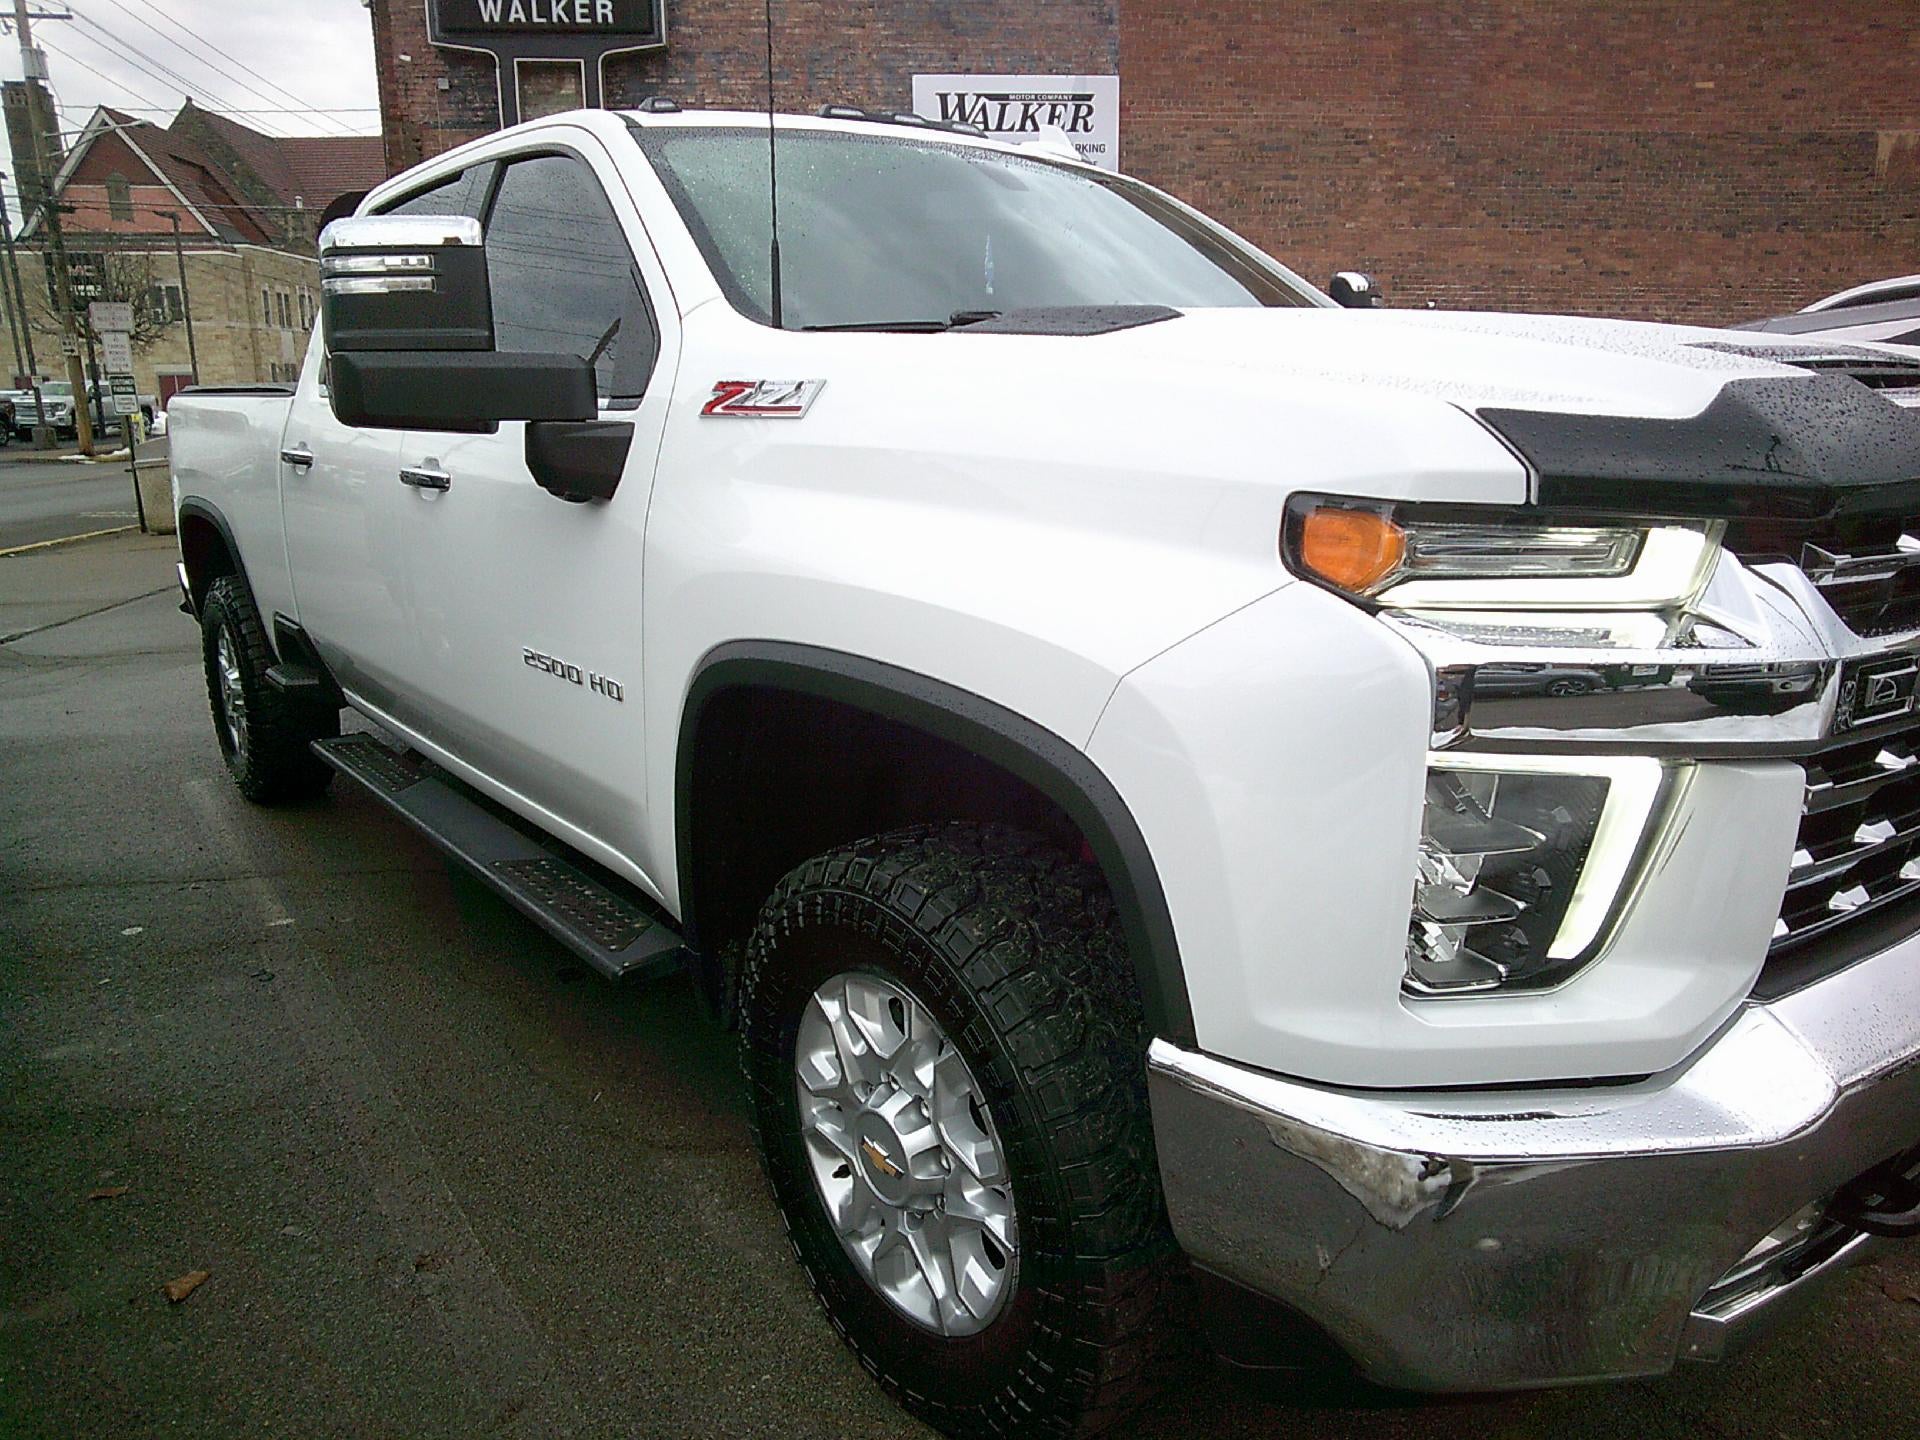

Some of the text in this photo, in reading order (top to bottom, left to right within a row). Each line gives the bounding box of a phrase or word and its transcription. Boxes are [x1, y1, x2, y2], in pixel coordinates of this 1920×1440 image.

[479, 0, 615, 24] WALKER
[935, 92, 1095, 133] WALKER
[1075, 143, 1106, 153] RKING
[699, 380, 826, 420] Z71
[523, 646, 625, 703] 2500 HD
